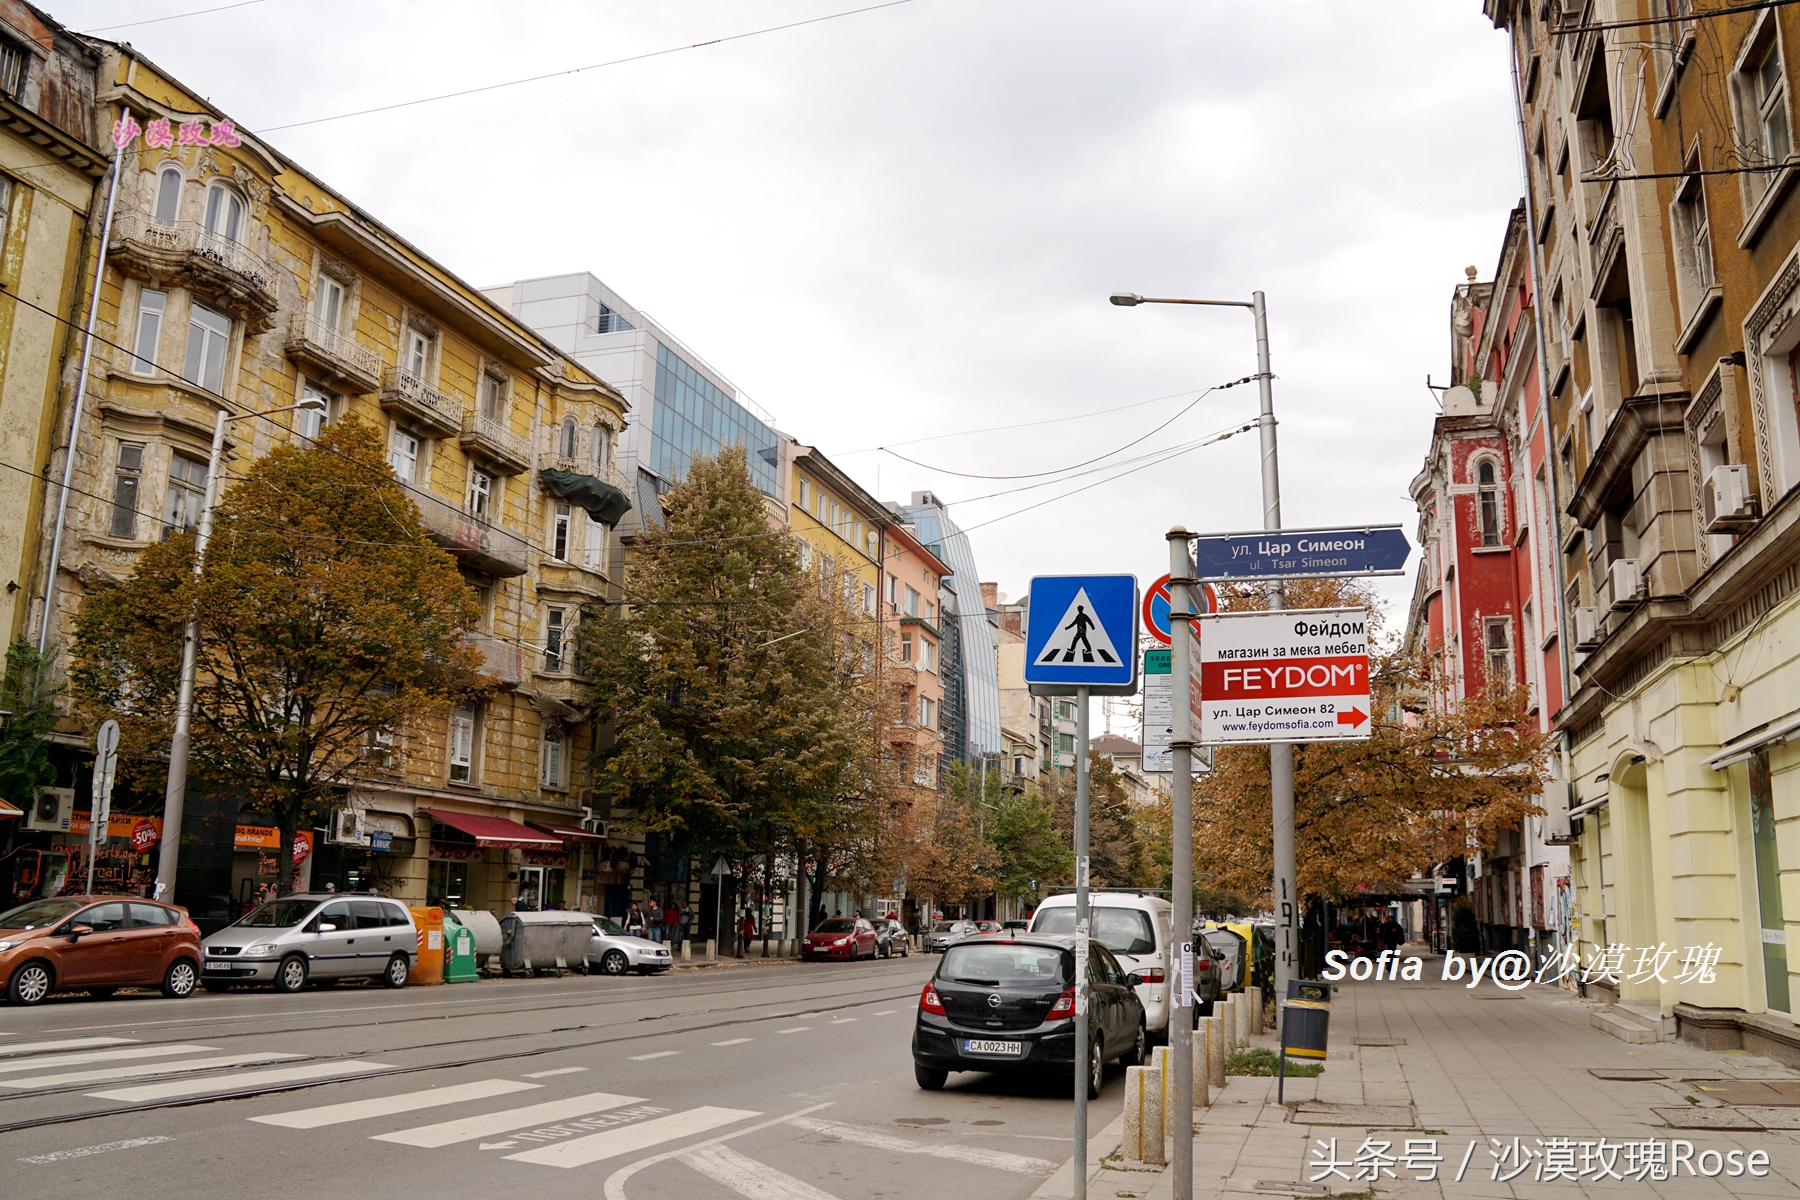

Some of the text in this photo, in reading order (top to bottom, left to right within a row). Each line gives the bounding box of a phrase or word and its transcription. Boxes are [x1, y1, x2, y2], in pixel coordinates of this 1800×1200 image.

[1231, 539, 1365, 559] ул. Цар Симеон
[1250, 556, 1347, 570] ul. Tsar Simeon
[1294, 620, 1364, 638] Фейдом
[1218, 642, 1365, 659] магазин за мека мебел
[1212, 704, 1335, 719] ул. Цар Симеон 82
[1222, 719, 1334, 733] www.feydomsofia.com
[132, 828, 157, 845] -50%
[247, 828, 273, 837] BRANDS
